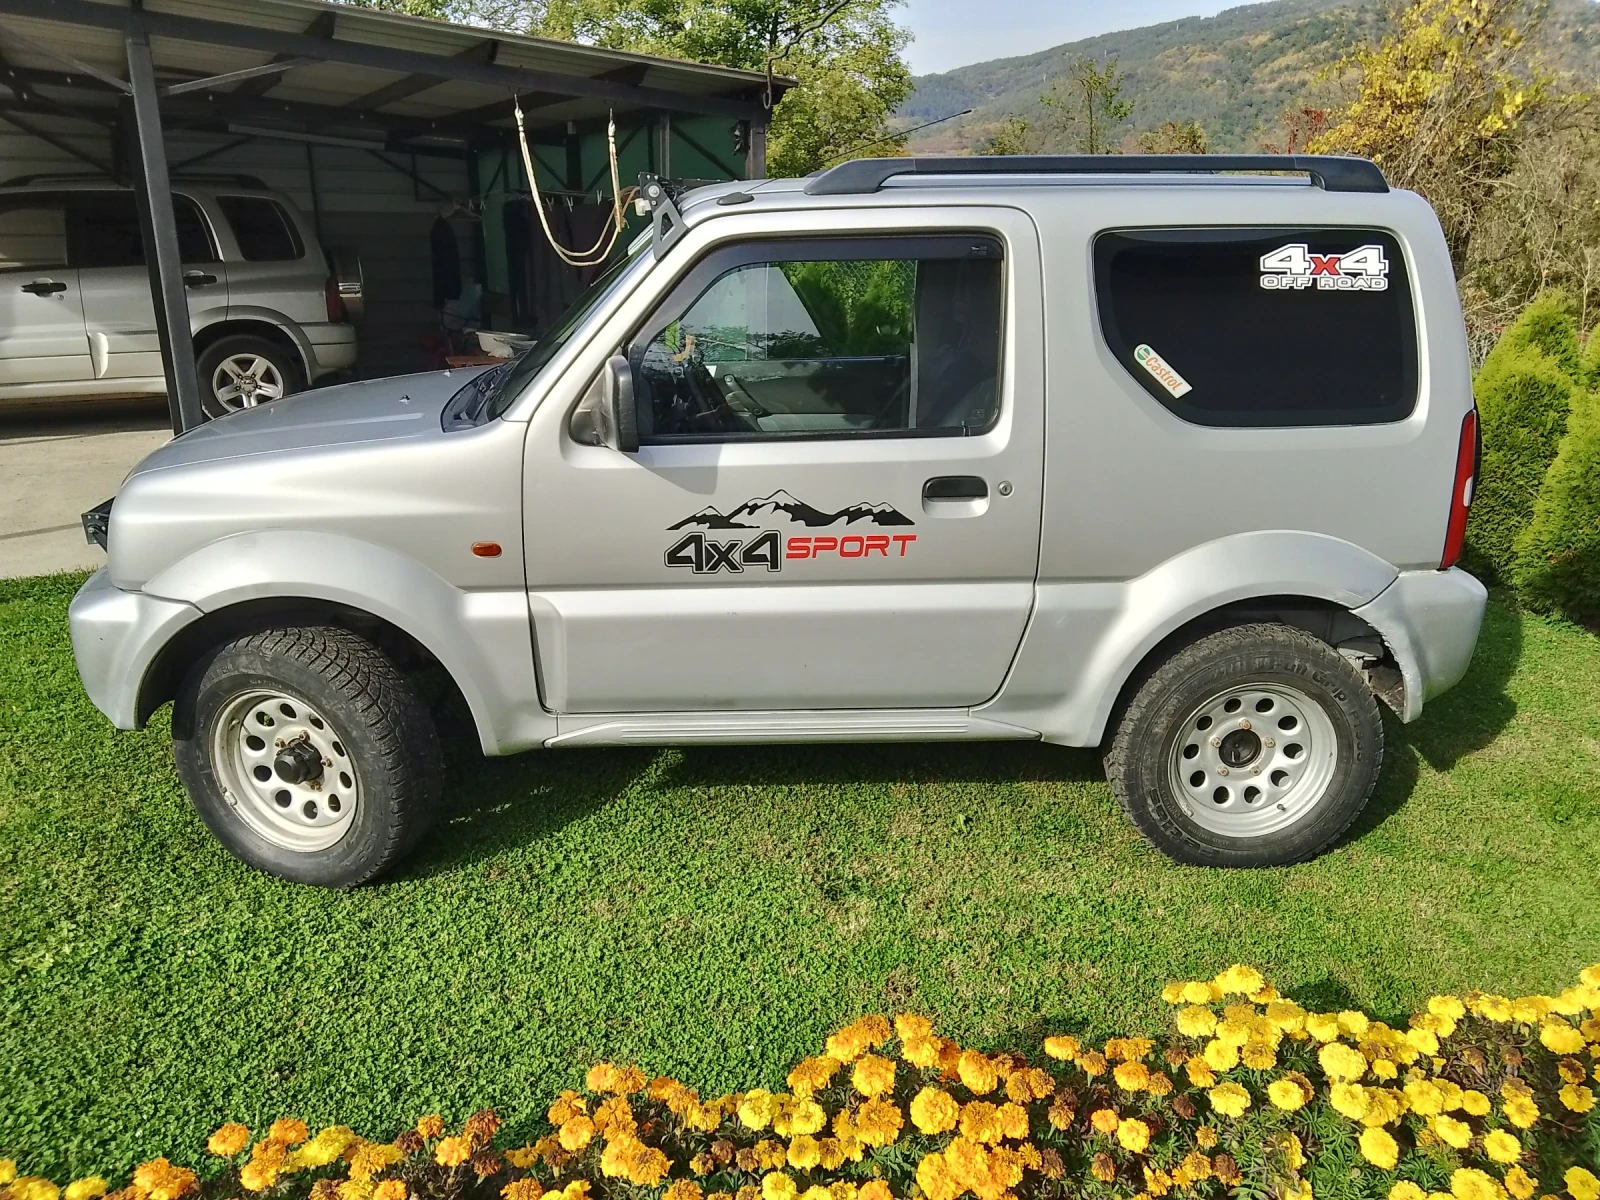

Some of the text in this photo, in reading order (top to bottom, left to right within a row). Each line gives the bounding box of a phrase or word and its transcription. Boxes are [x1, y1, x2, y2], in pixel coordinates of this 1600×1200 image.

[1260, 244, 1389, 277] 4x4
[1260, 274, 1388, 291] OFF ROAD
[1145, 357, 1183, 391] Castrol
[664, 530, 917, 574] 4x4 SPORT
